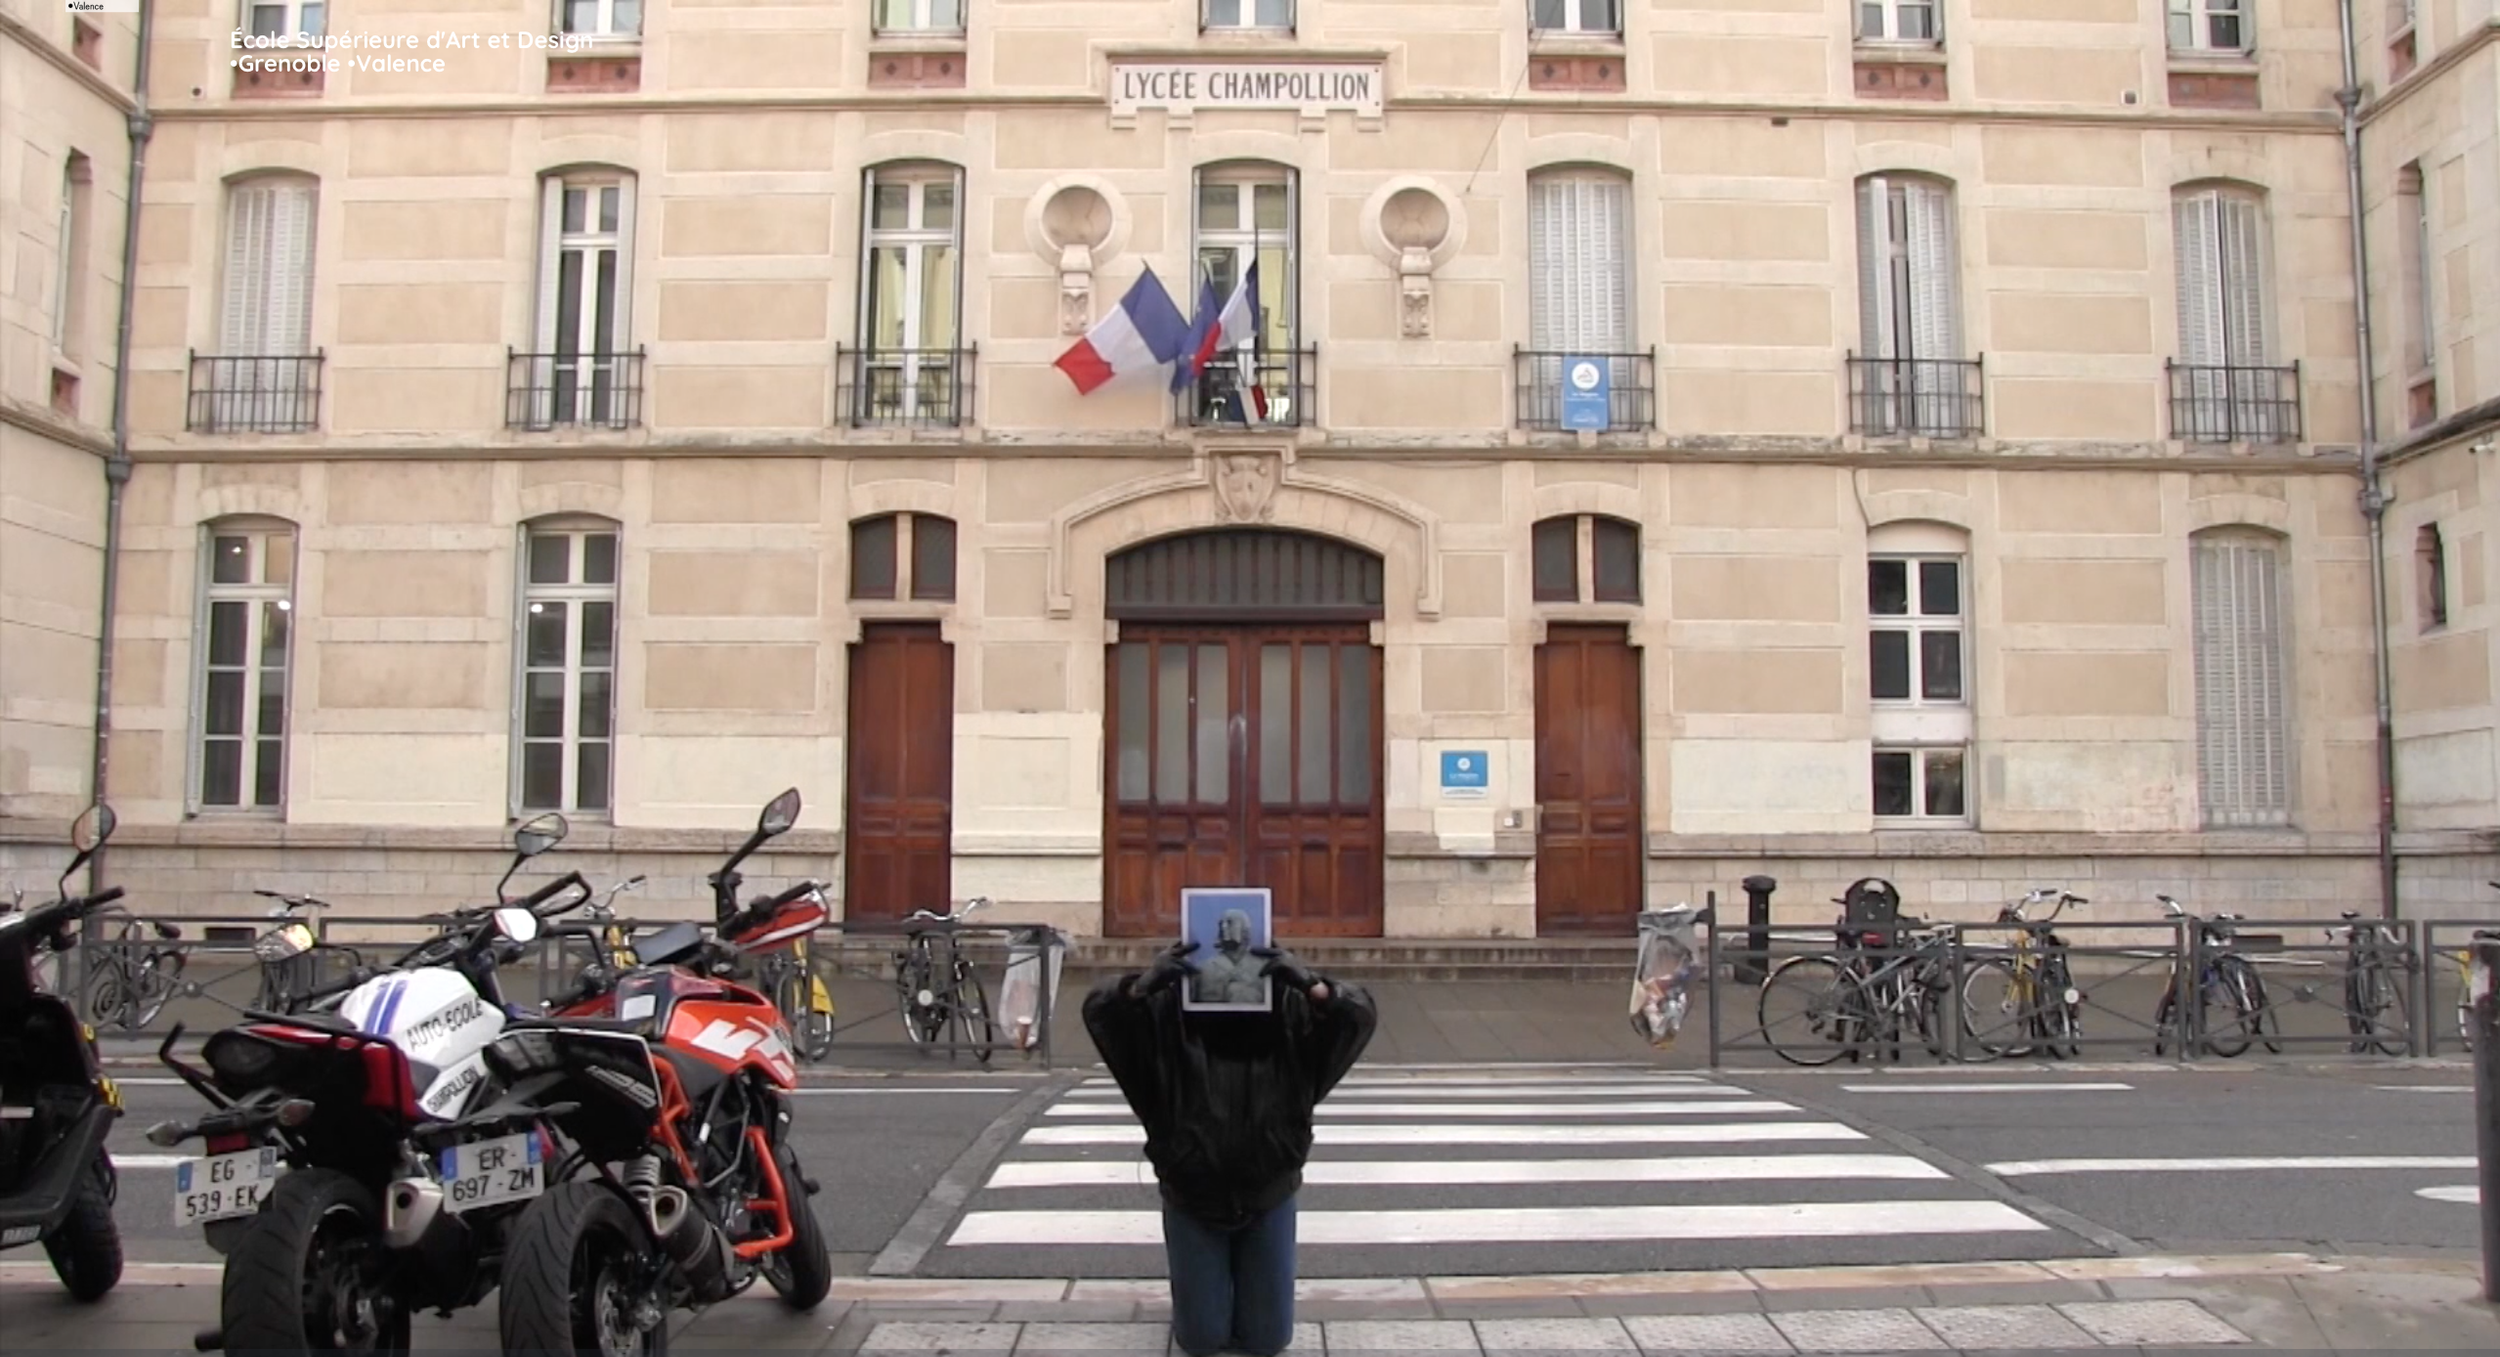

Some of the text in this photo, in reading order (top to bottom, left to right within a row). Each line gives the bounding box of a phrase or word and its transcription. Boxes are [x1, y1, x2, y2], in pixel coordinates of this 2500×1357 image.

[1124, 68, 1370, 101] LYCÉE CHAMPOLLION
[405, 994, 484, 1053] AUTO-ECOLE
